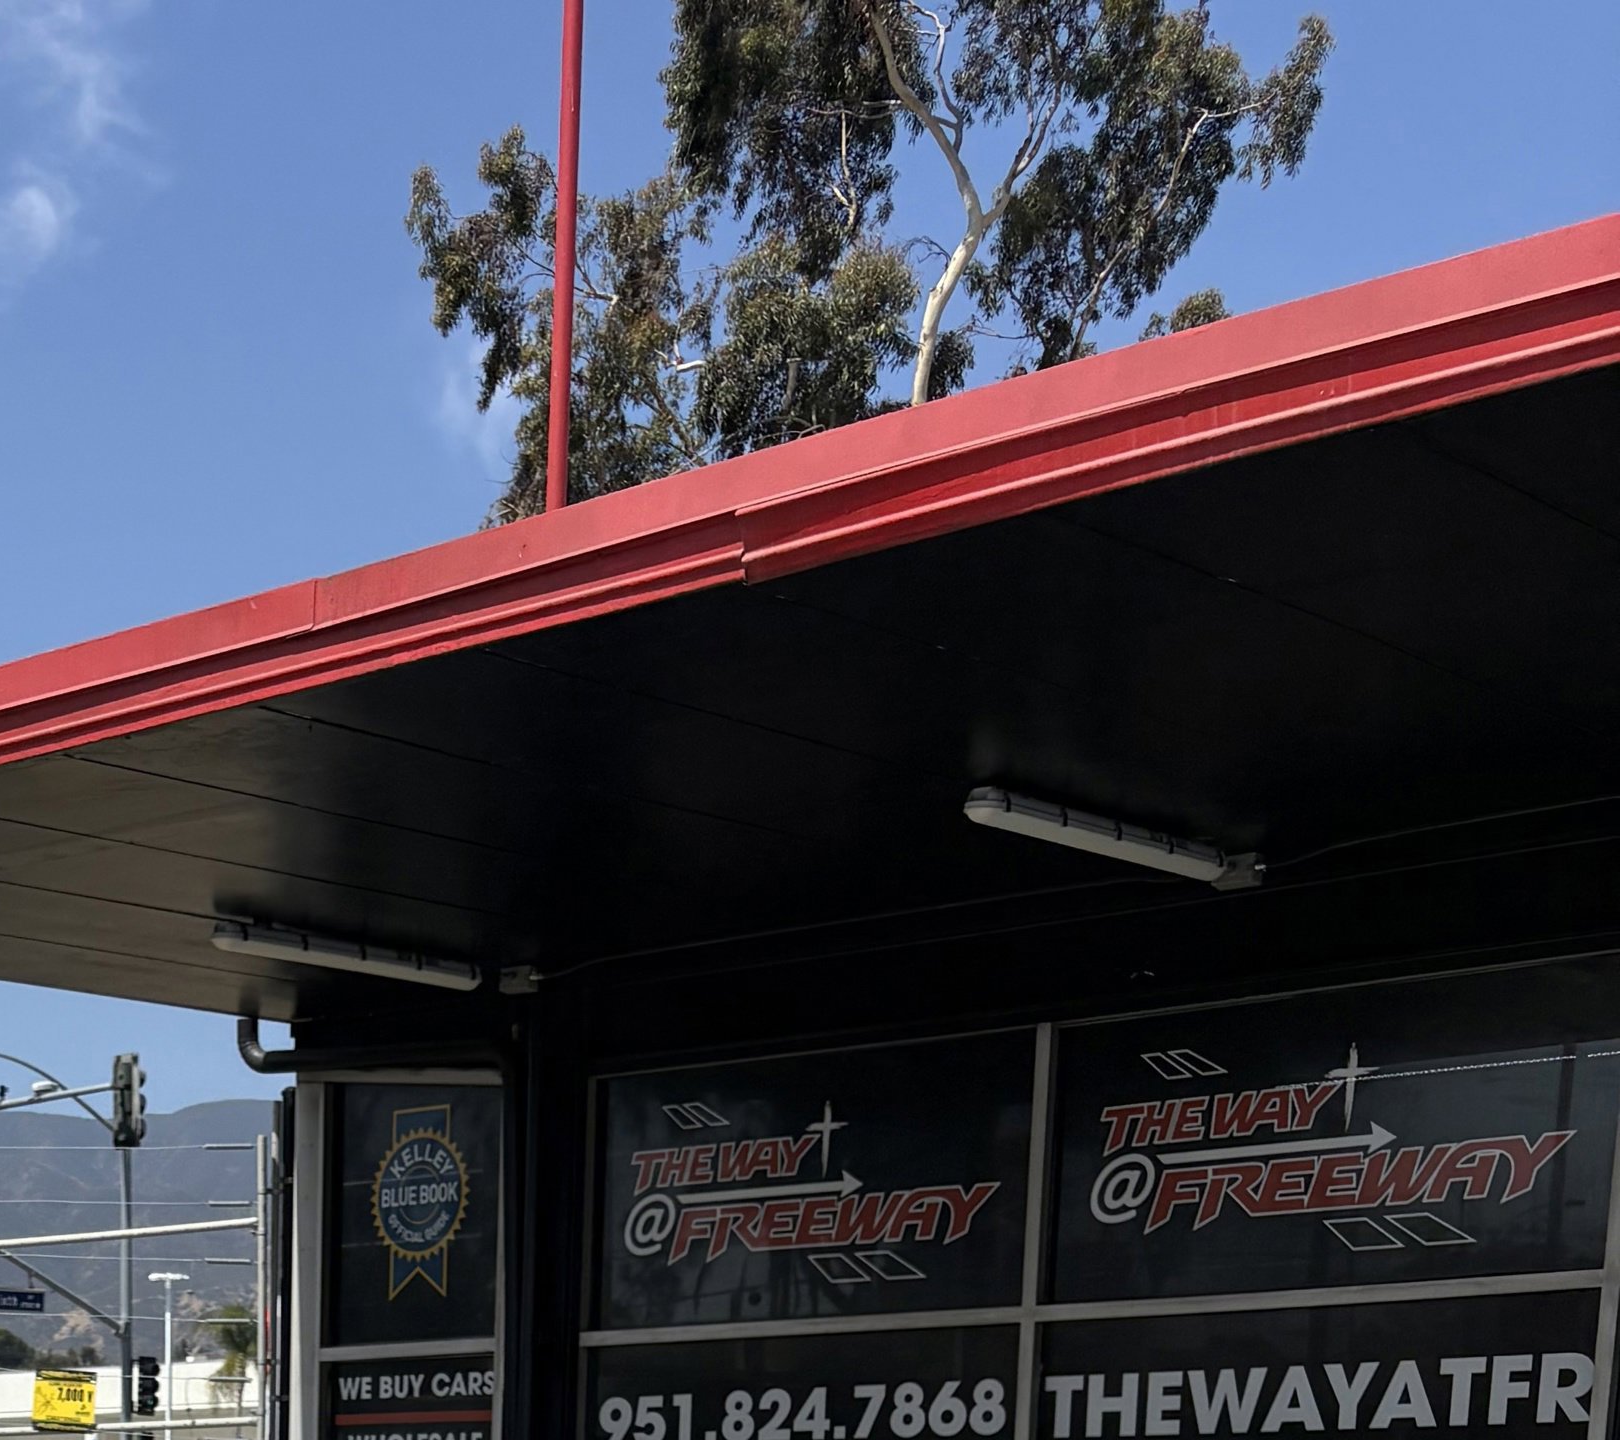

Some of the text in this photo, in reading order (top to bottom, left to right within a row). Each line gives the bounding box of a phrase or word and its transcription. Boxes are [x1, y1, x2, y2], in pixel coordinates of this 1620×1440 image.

[390, 1143, 454, 1178] KELLEY
[381, 1182, 459, 1208] BLUE BOOK
[388, 1214, 424, 1242] OFFICIAL
[338, 1370, 495, 1400] WE BUY CARS
[1044, 1352, 1596, 1438] THEWAYATFR
